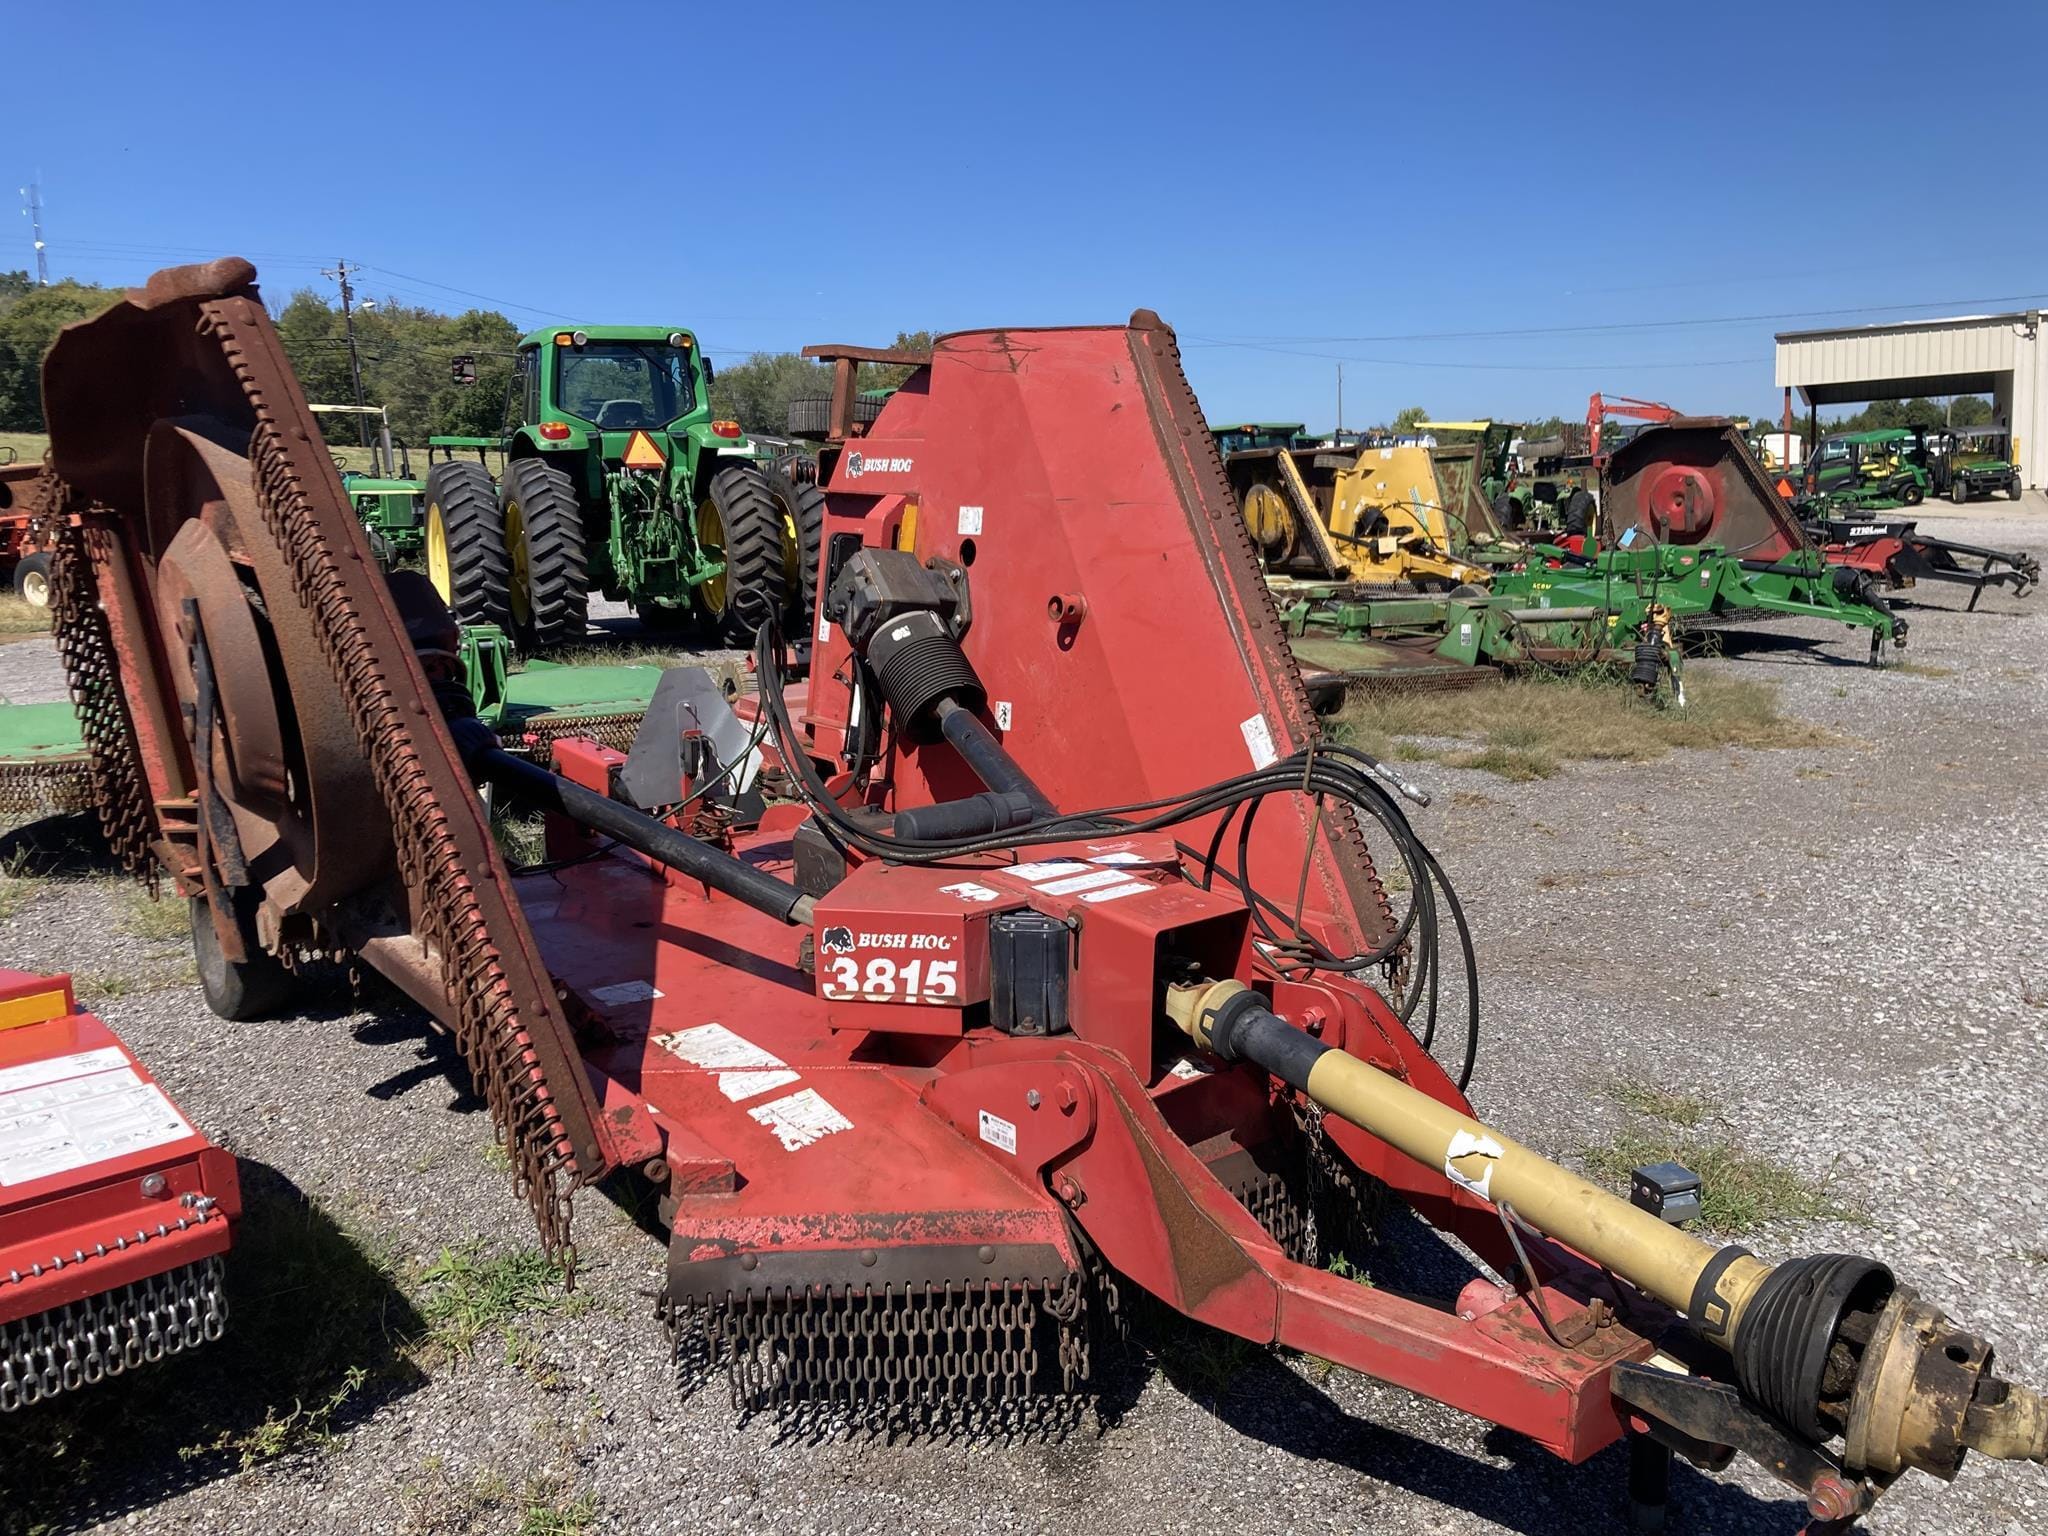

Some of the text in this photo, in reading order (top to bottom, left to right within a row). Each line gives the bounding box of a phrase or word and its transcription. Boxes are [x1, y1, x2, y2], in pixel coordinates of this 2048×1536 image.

[863, 458, 912, 473] BUSH HOG
[857, 933, 951, 949] BUSH HOG
[822, 957, 957, 1004] 3815
